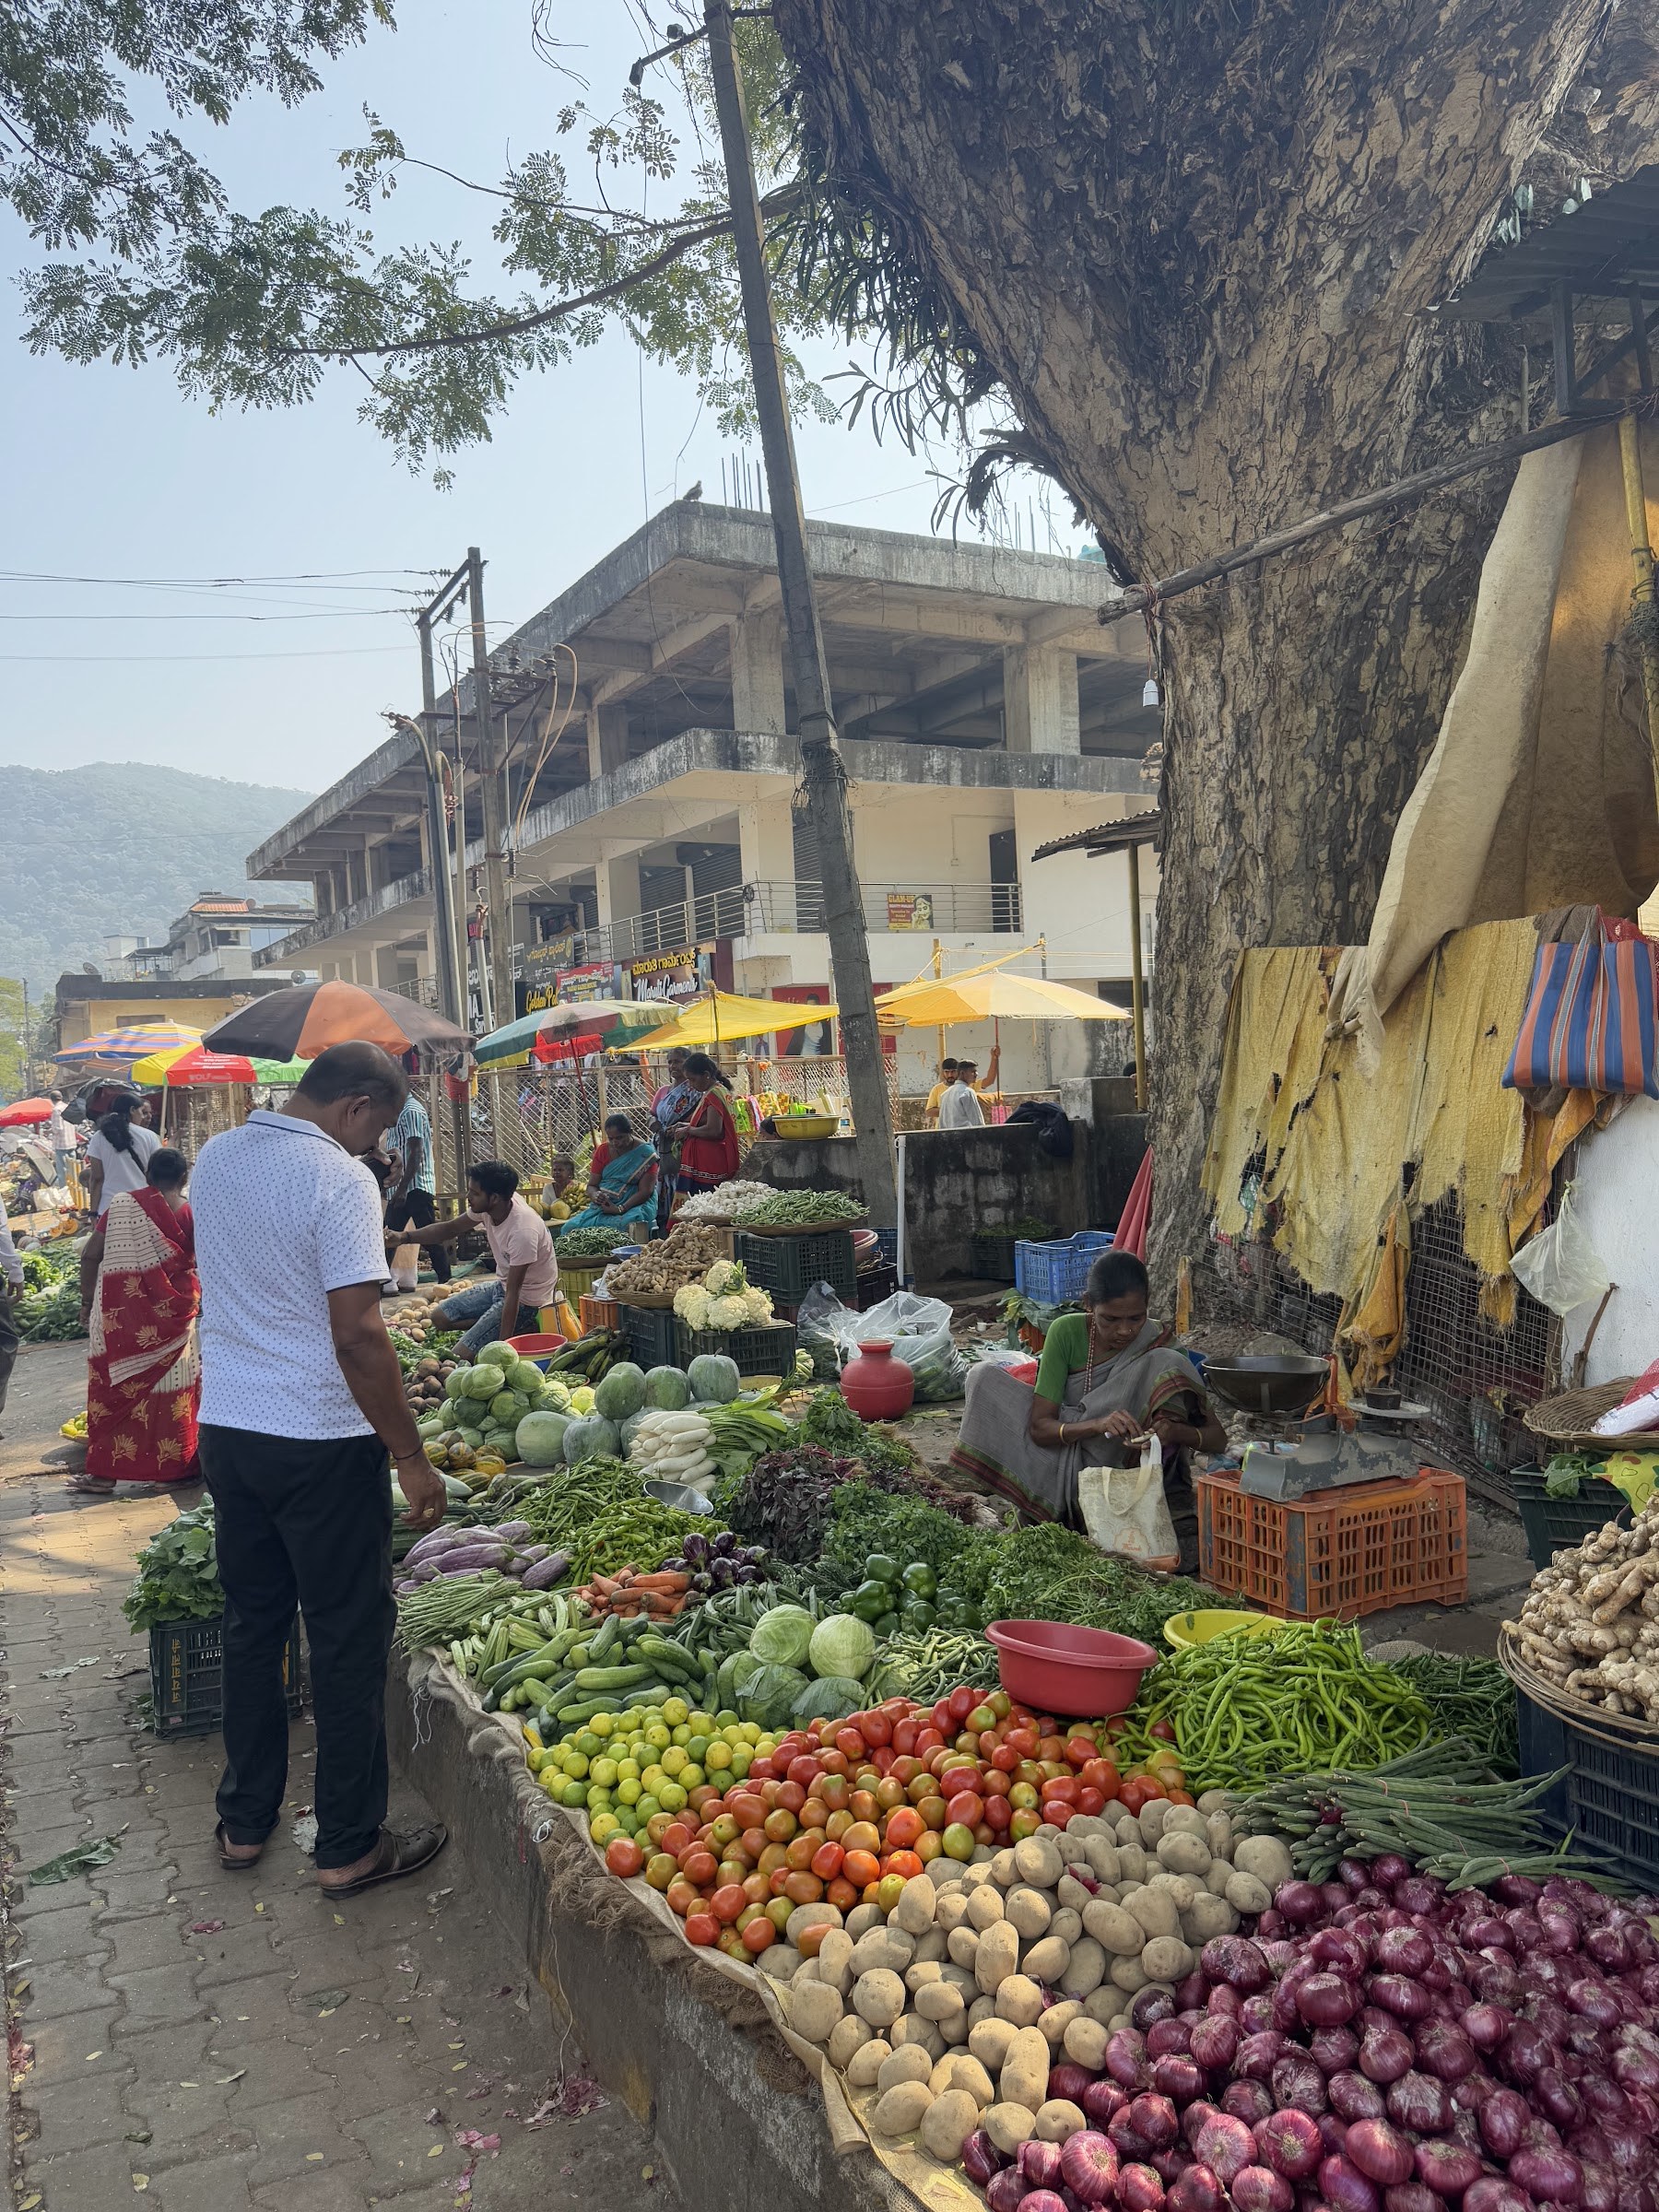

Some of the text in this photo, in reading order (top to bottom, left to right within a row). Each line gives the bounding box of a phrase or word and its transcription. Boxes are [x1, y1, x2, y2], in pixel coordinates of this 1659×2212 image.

[888, 895, 914, 903] GLAM-UP
[632, 958, 657, 976] ಮಾರುತಿ
[633, 977, 663, 1002] Maruti
[663, 973, 698, 1003] Garments
[525, 990, 547, 1015] Golden
